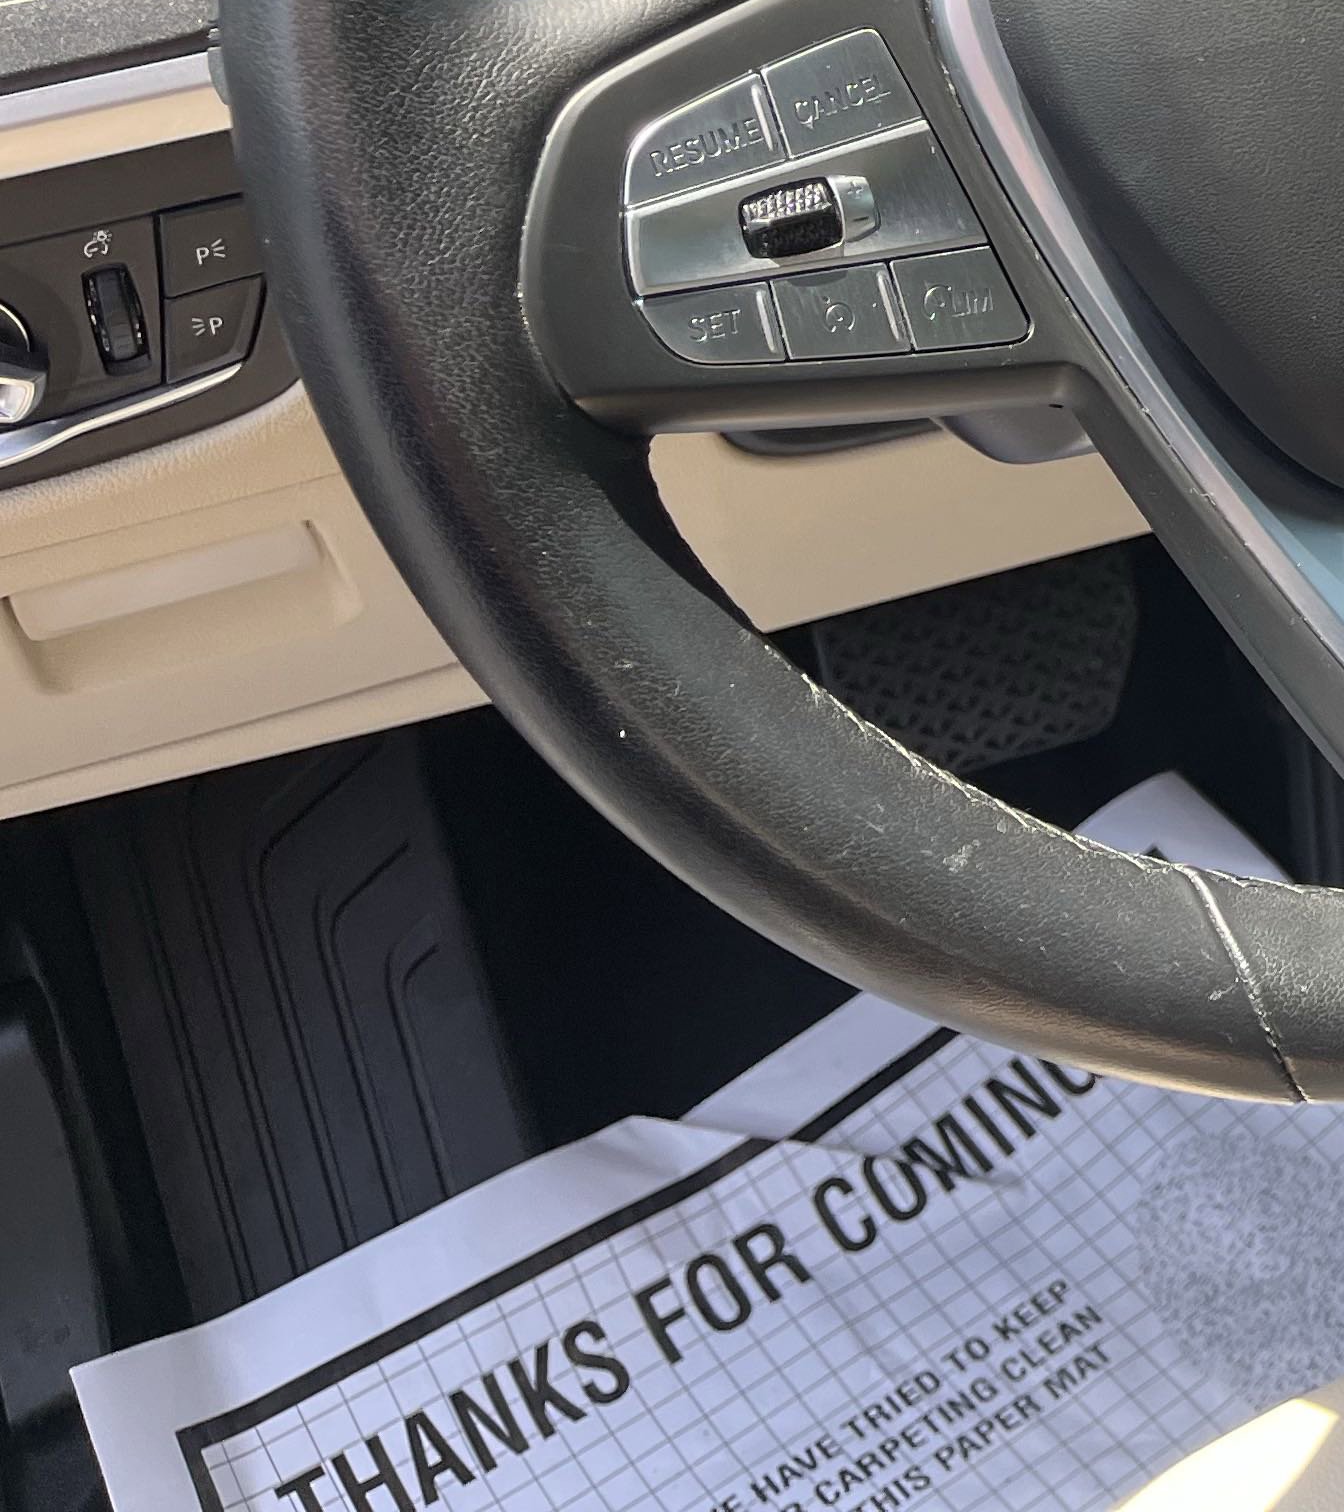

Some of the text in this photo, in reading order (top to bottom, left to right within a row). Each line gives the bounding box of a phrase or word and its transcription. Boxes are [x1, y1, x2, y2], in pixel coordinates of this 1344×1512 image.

[650, 118, 765, 178] RESUME
[794, 76, 892, 130] CANCEL
[688, 309, 742, 344] SET
[274, 1320, 631, 1512] THANKS
[634, 1222, 812, 1364] FOR
[750, 1279, 1070, 1503] HAVE TRIED TO KEEP
[814, 1304, 1104, 1507] CARPETING CLEAN
[936, 1392, 1043, 1472] PAPER
[1043, 1340, 1113, 1402] MAT
